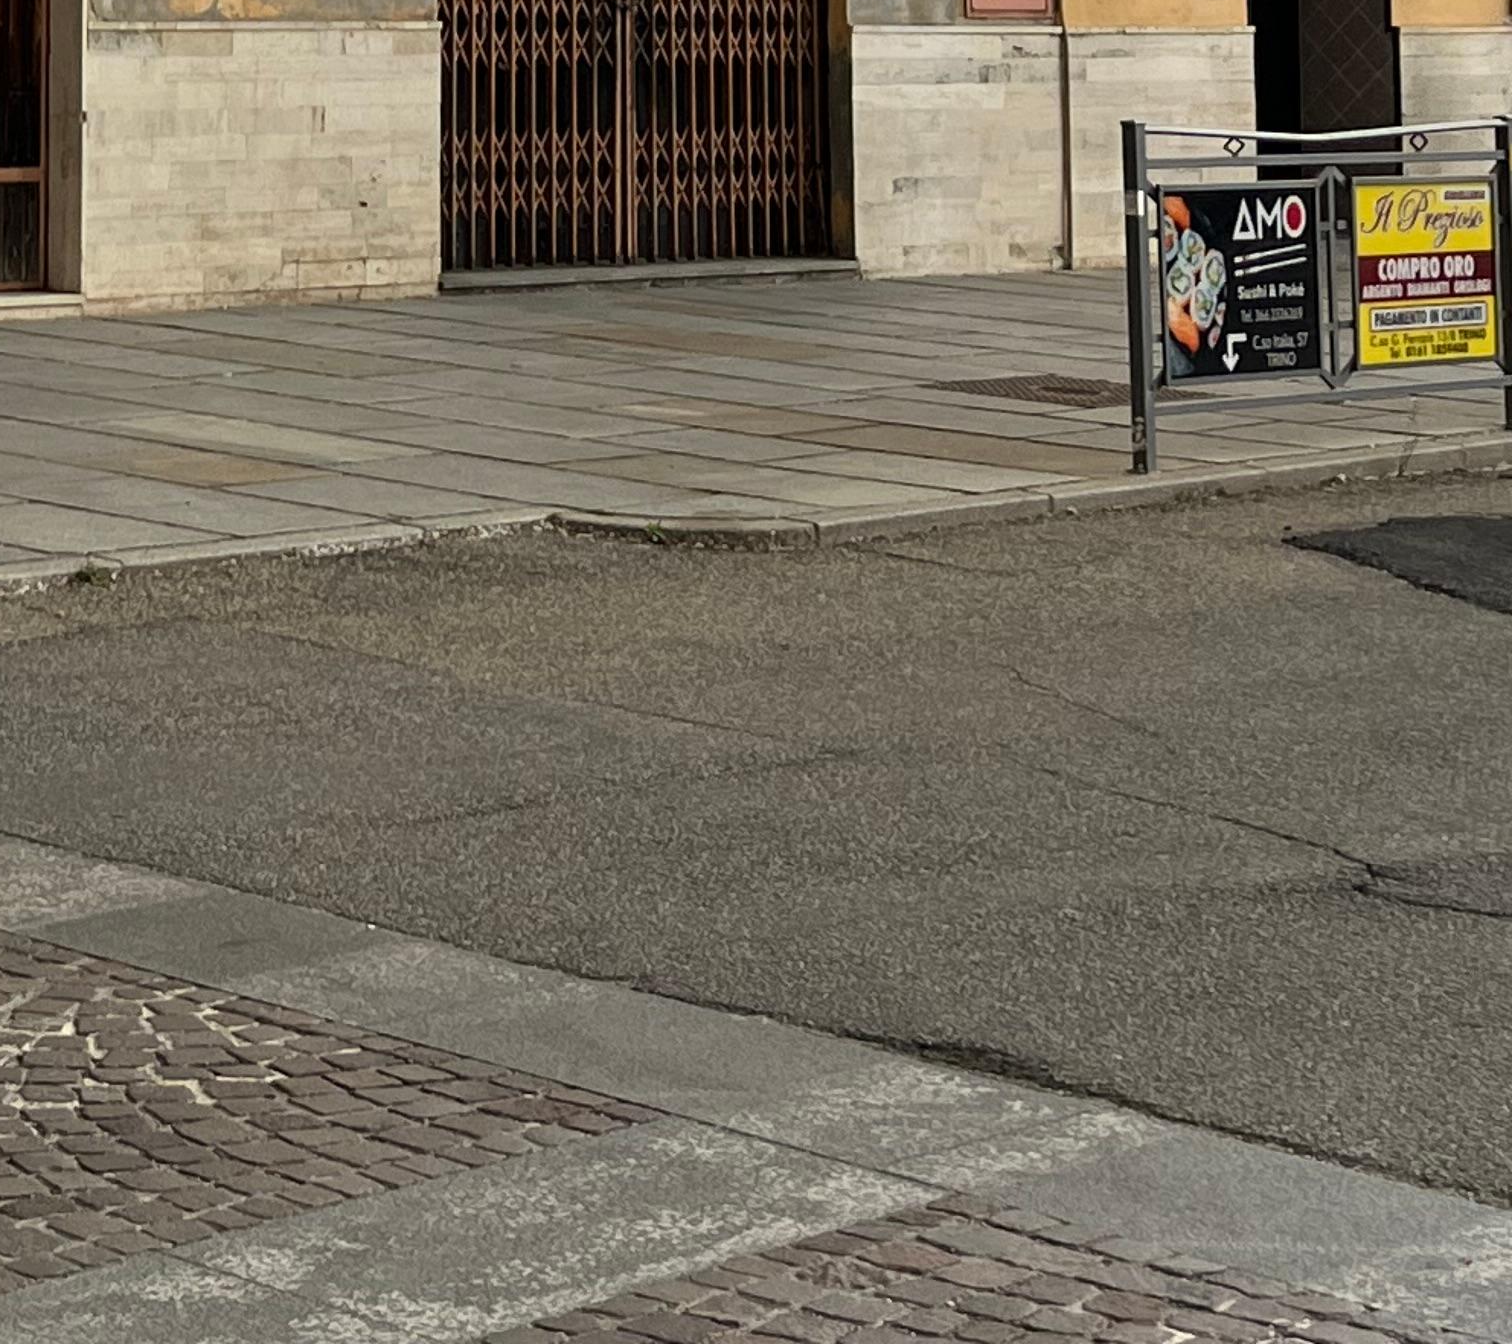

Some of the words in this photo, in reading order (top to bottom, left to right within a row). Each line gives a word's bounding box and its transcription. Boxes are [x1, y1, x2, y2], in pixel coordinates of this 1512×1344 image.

[1232, 194, 1307, 241] AMO
[1360, 190, 1394, 234] Il
[1397, 188, 1484, 249] Prezioso
[1377, 255, 1441, 282] COMPRO
[1443, 254, 1475, 278] ORO
[1237, 284, 1267, 300] Sushi
[1269, 283, 1277, 298] &
[1362, 282, 1403, 300] ARGENTO
[1374, 310, 1428, 328] PAGAMENTO
[1429, 309, 1439, 324] IN
[1441, 306, 1484, 322] CONTANTI
